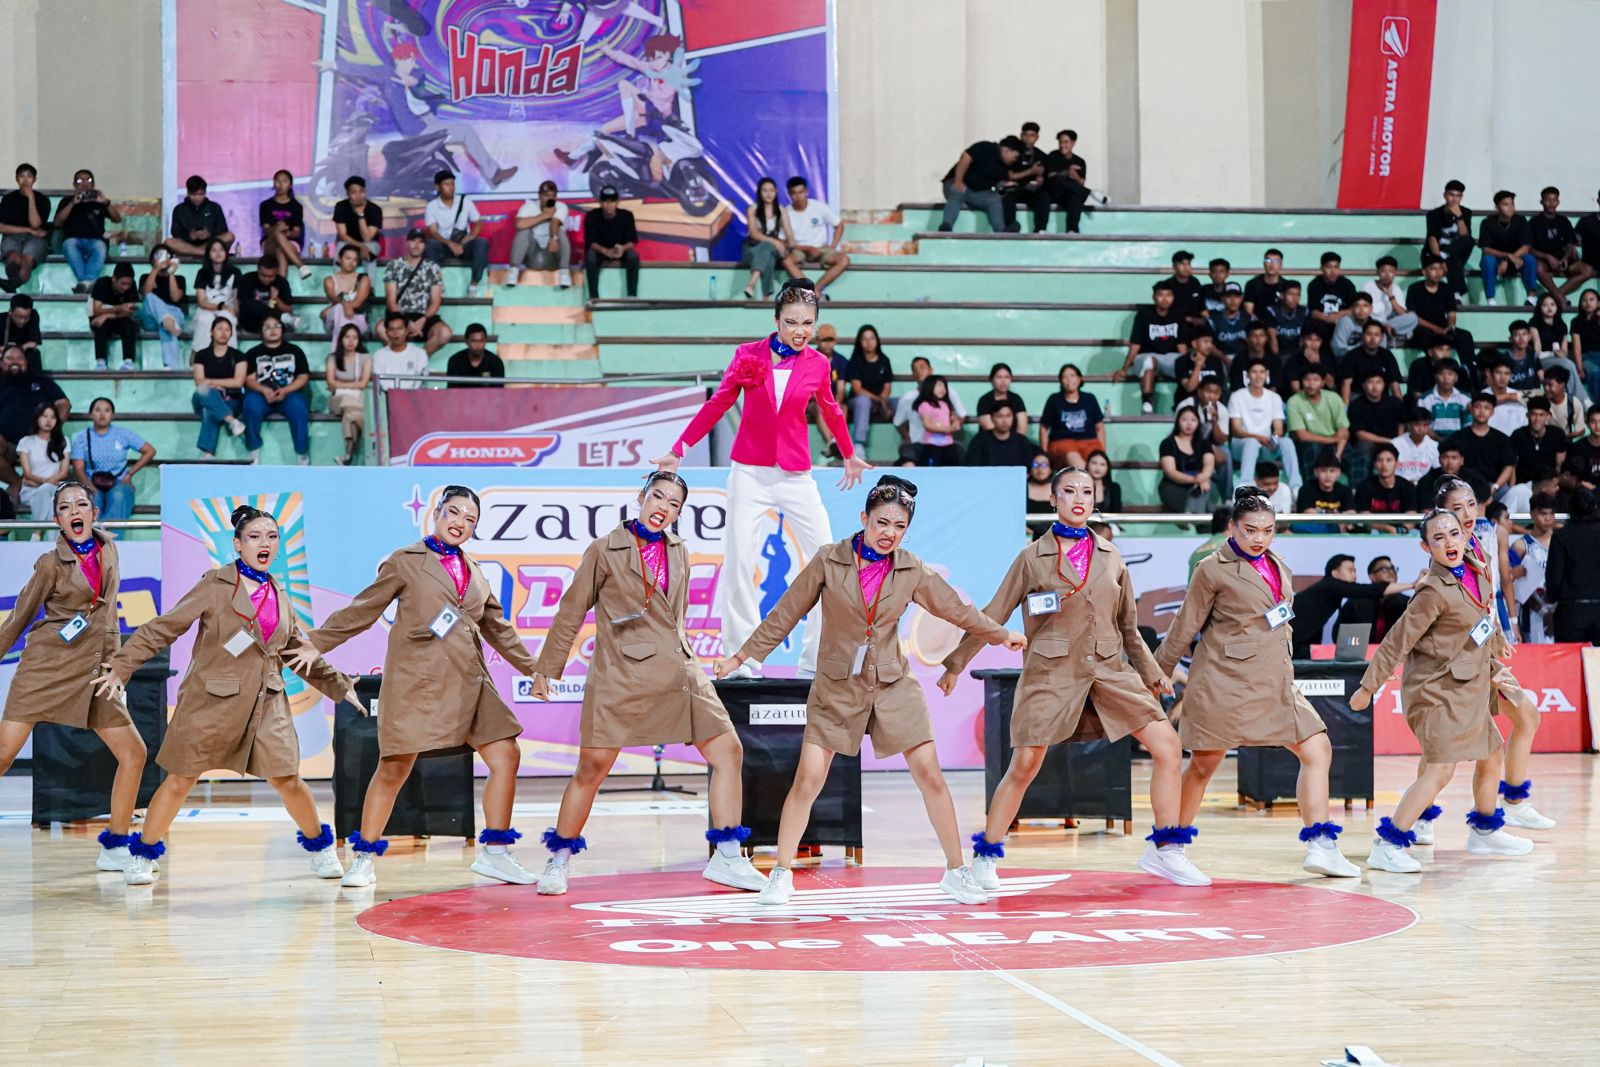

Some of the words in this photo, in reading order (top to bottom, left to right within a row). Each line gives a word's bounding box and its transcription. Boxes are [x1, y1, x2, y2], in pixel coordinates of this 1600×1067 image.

[448, 26, 585, 103] Honda
[1383, 59, 1398, 112] ASTRA
[1379, 117, 1394, 176] MOTOR
[449, 447, 525, 458] HONDA
[578, 439, 643, 466] LET'S
[470, 503, 726, 541] zare
[751, 709, 806, 719] azarin
[586, 908, 1199, 927] HONDA
[609, 938, 843, 953] One
[863, 926, 1266, 948] HEART.
